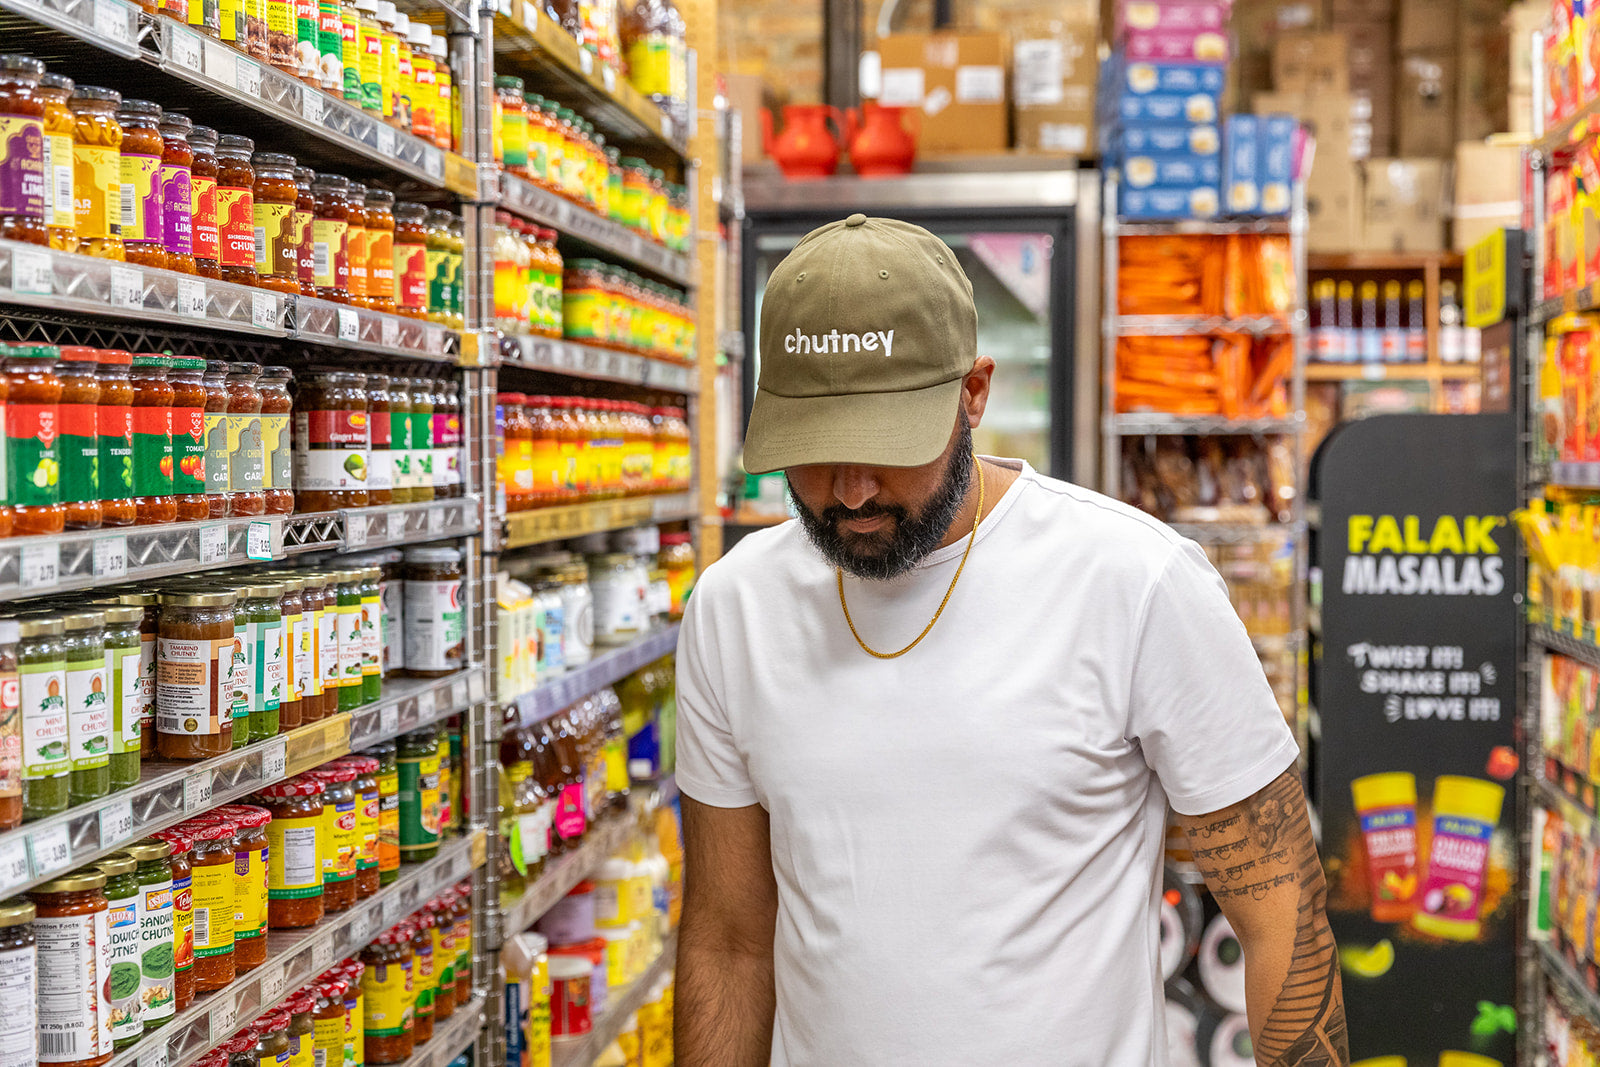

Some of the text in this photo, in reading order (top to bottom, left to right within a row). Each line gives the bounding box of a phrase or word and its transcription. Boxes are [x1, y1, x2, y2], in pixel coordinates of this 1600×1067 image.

[187, 51, 198, 68] 2.79
[230, 241, 255, 252] CHUN
[129, 289, 141, 304] 2.49
[193, 297, 204, 312] 2.49
[784, 328, 895, 357] chutney
[213, 473, 228, 482] GAR
[1347, 514, 1500, 555] FALAK
[40, 565, 55, 581] 2.79
[1342, 554, 1505, 596] MASALAS
[169, 644, 199, 652] TAMARIND
[1347, 642, 1464, 669] TWIST IT!
[1360, 669, 1482, 696] SHAKE IT!
[1468, 697, 1501, 722] IT!
[200, 786, 211, 803] 3.99
[119, 816, 131, 833] 3.99
[49, 1023, 63, 1032] 250g
